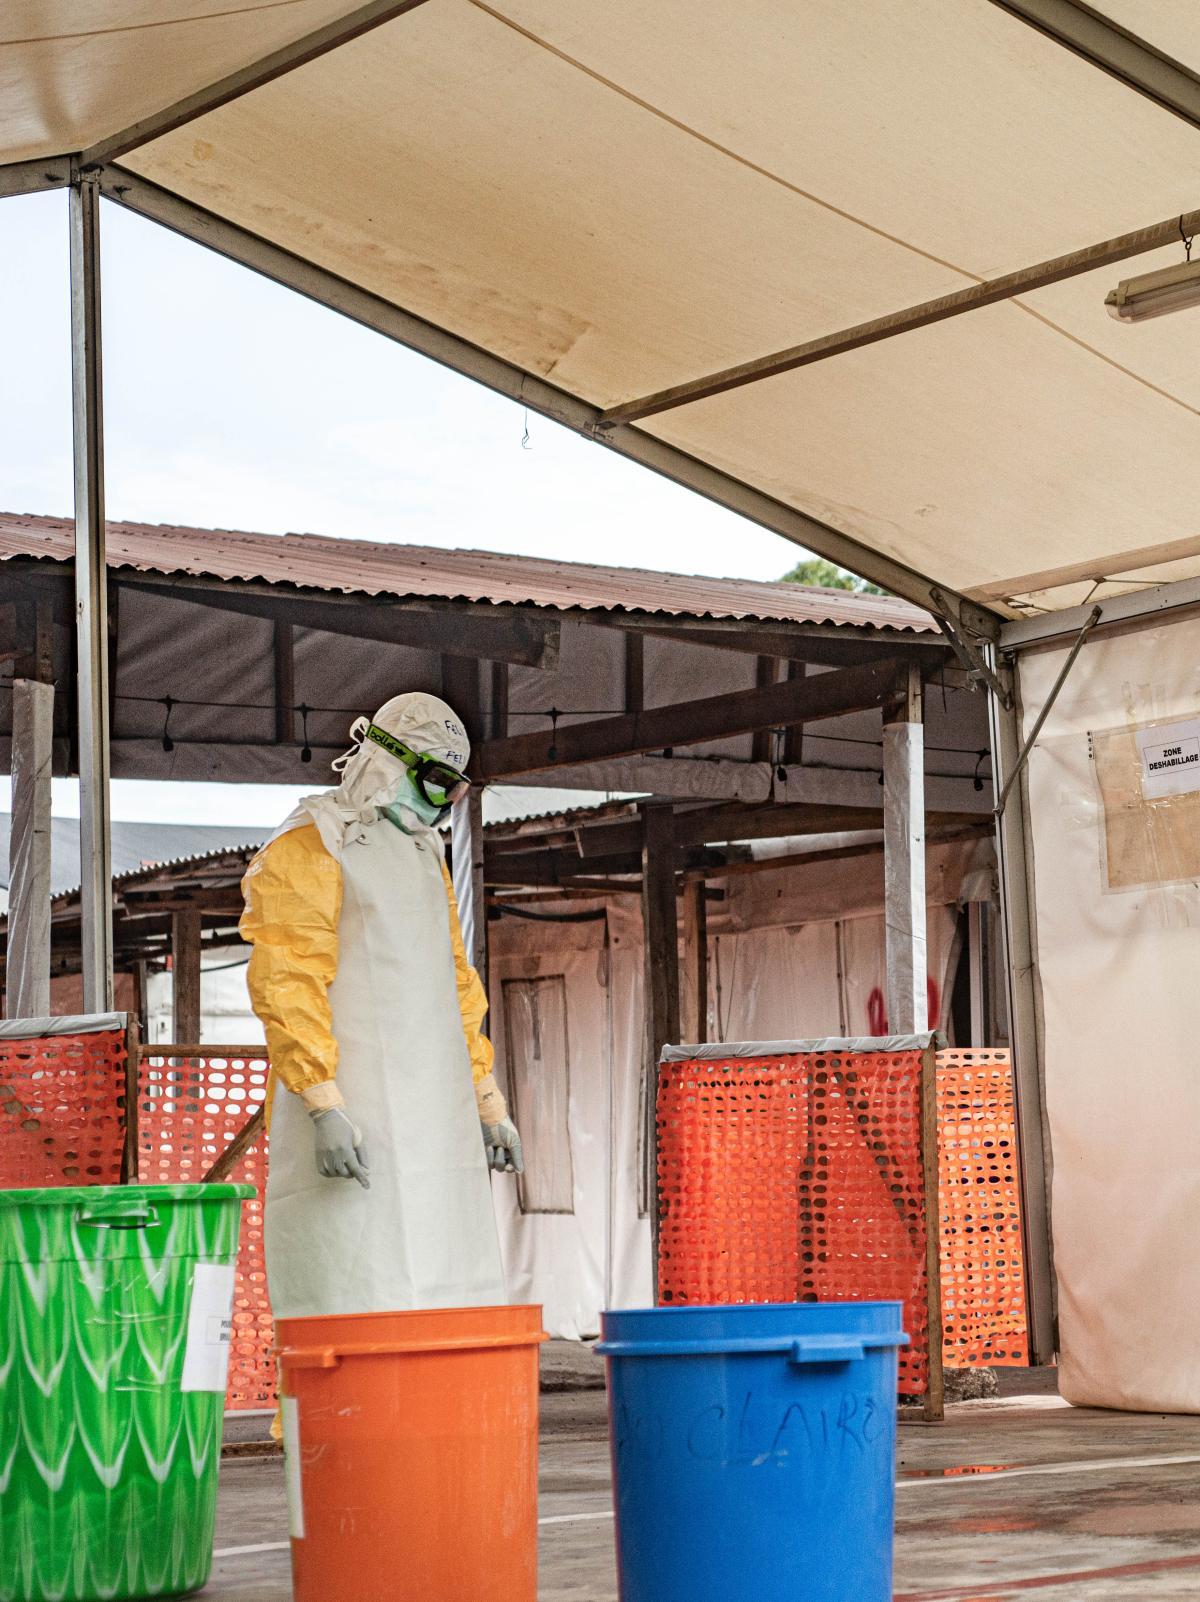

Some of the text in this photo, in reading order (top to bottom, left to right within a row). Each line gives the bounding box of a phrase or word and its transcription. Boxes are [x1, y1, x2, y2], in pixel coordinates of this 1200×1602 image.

[370, 729, 396, 750] bollé
[1163, 747, 1182, 757] ZONE
[1149, 754, 1199, 770] DESHABILLAGE
